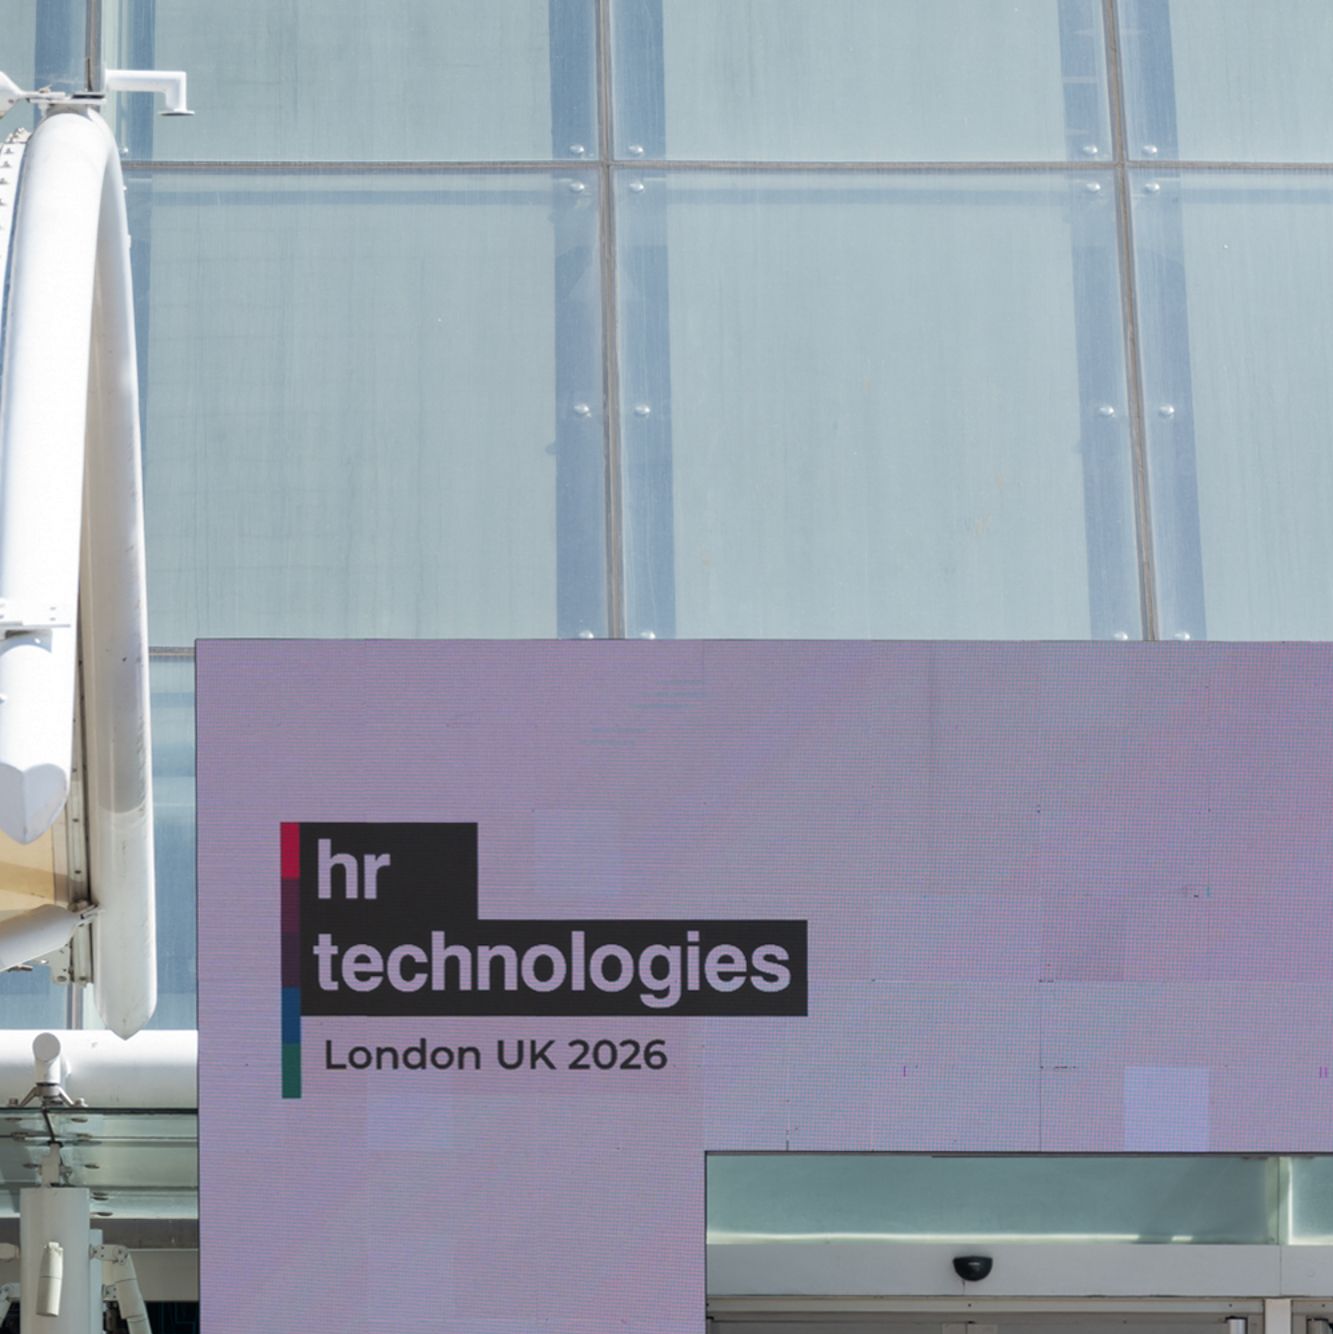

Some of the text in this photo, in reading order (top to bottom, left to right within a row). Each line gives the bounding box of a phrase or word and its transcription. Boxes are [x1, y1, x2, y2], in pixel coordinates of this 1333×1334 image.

[317, 838, 391, 900] hr
[313, 930, 792, 1009] technologies
[325, 1037, 668, 1071] London UK 2026
